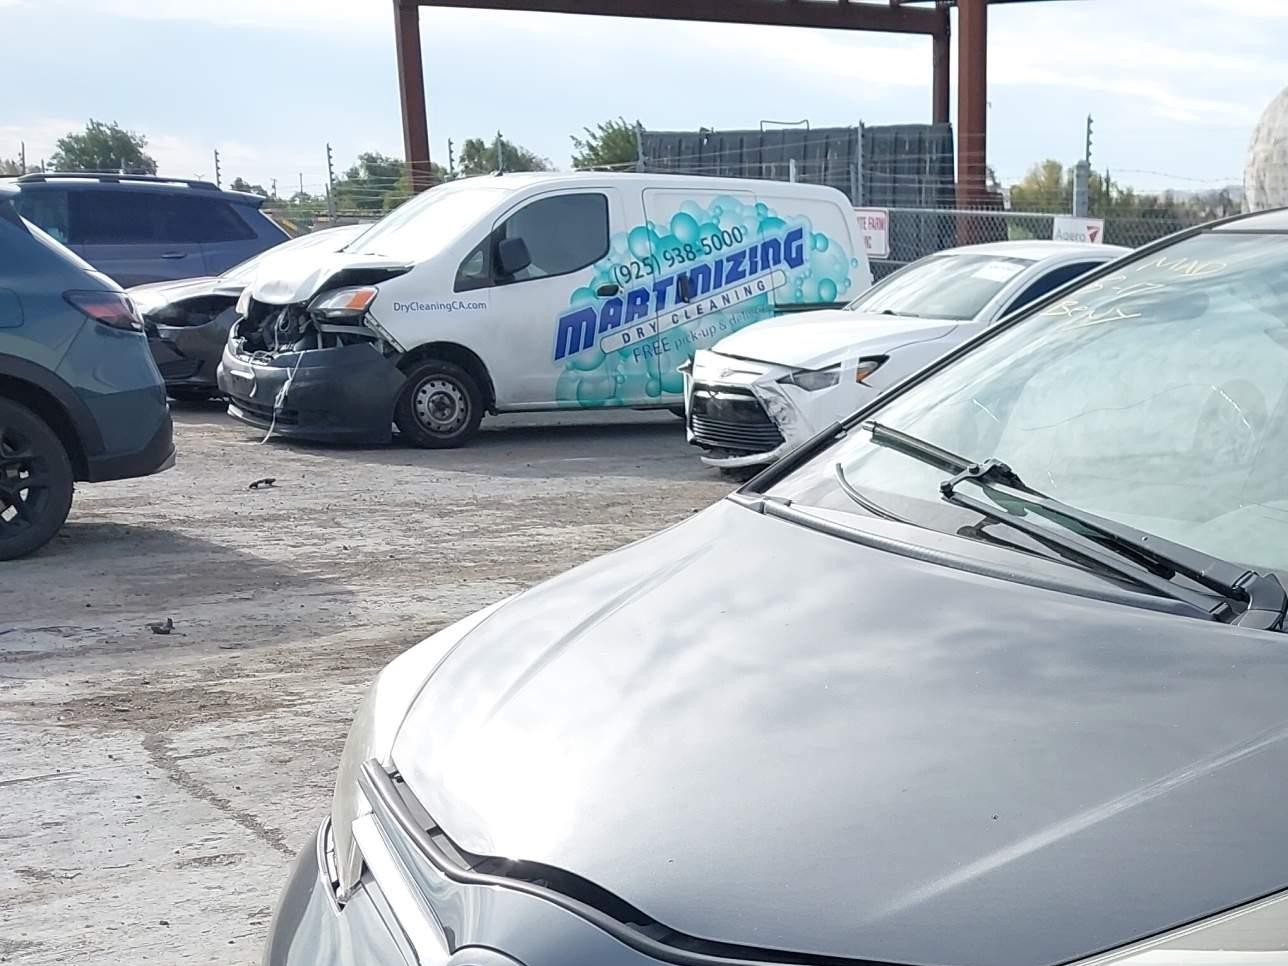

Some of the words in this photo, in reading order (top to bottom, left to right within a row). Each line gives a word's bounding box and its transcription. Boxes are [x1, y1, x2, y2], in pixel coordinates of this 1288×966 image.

[614, 254, 661, 289] (925)
[663, 226, 744, 269] 938-5000
[393, 301, 487, 312] DryCleaningCA.com
[554, 227, 806, 361] MARTINIZING
[622, 321, 659, 344] DRY
[671, 281, 767, 325] CLEANING
[633, 337, 672, 363] FREE
[674, 323, 717, 352] pick-up
